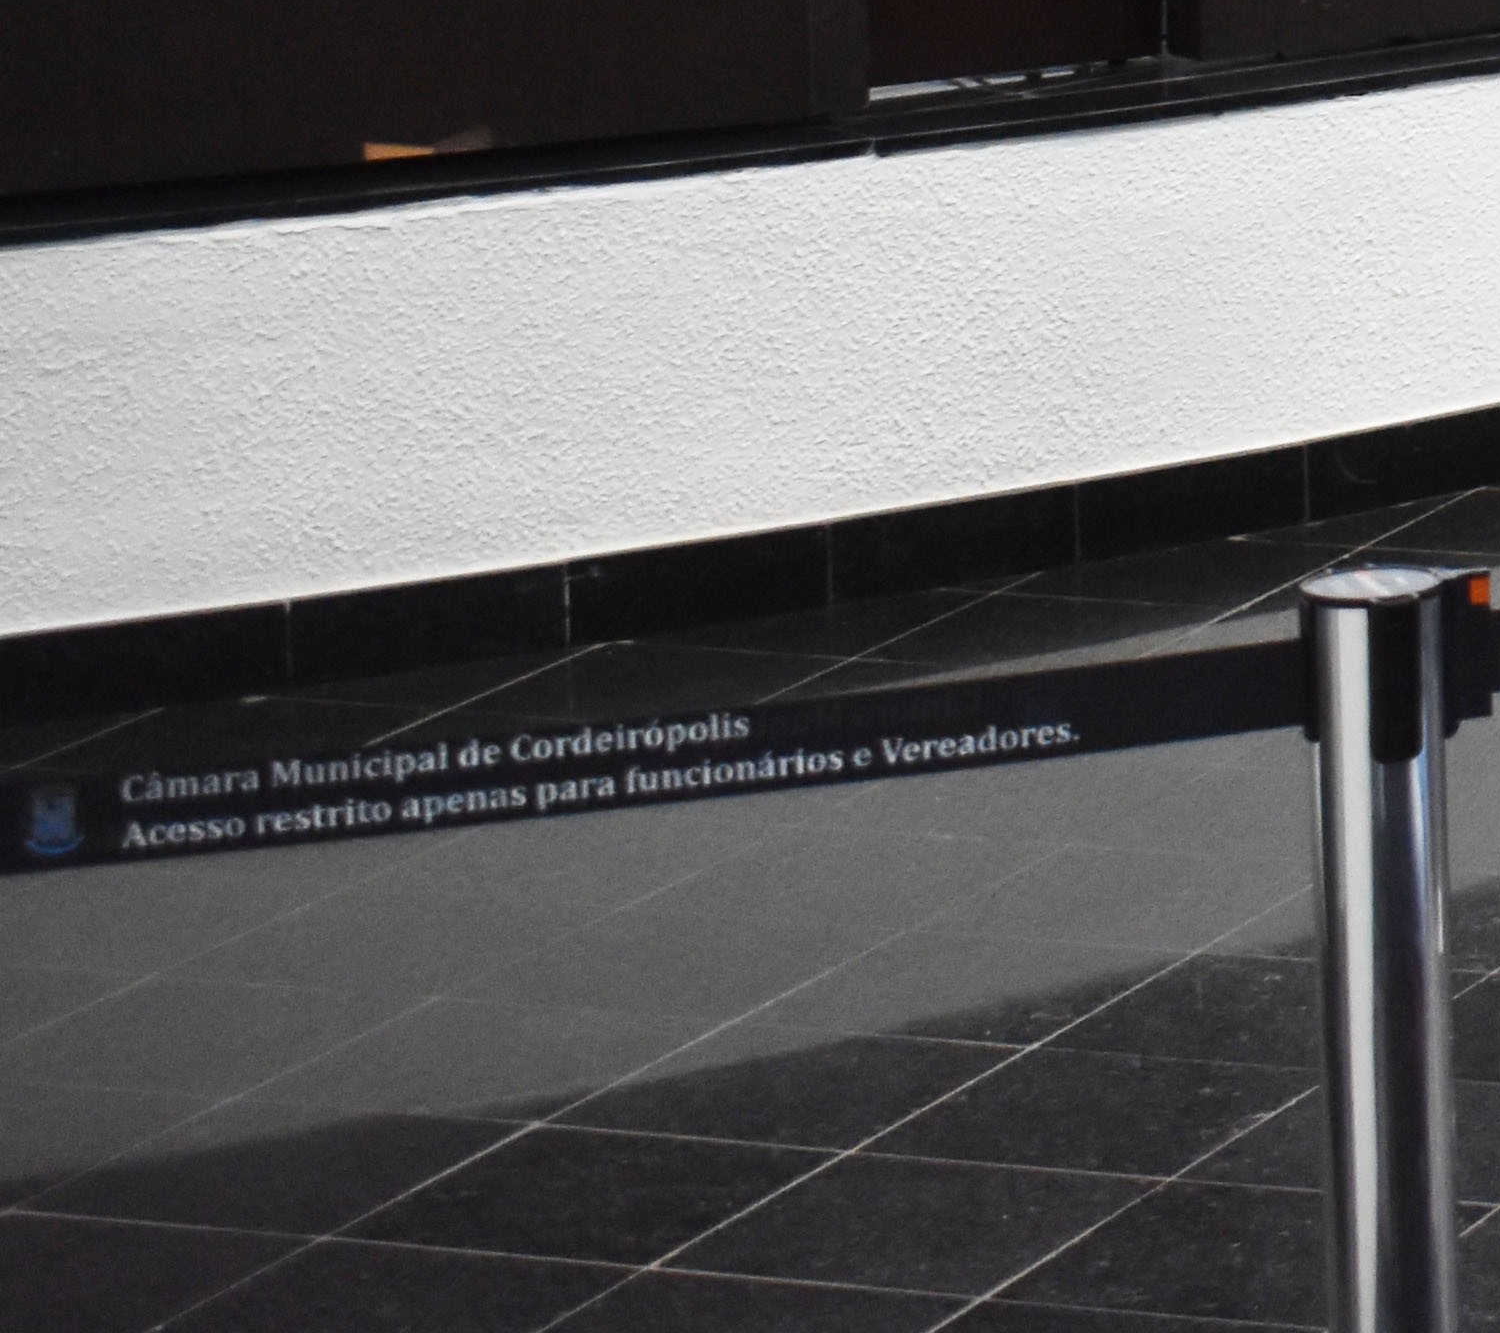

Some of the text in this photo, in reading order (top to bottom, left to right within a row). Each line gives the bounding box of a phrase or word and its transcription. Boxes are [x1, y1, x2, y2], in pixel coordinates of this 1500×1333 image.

[122, 712, 750, 802] Câmara Municipal de Cordeirópolis
[122, 723, 1080, 848] Acesso restrito apenas para funcionários e Vereadores.
